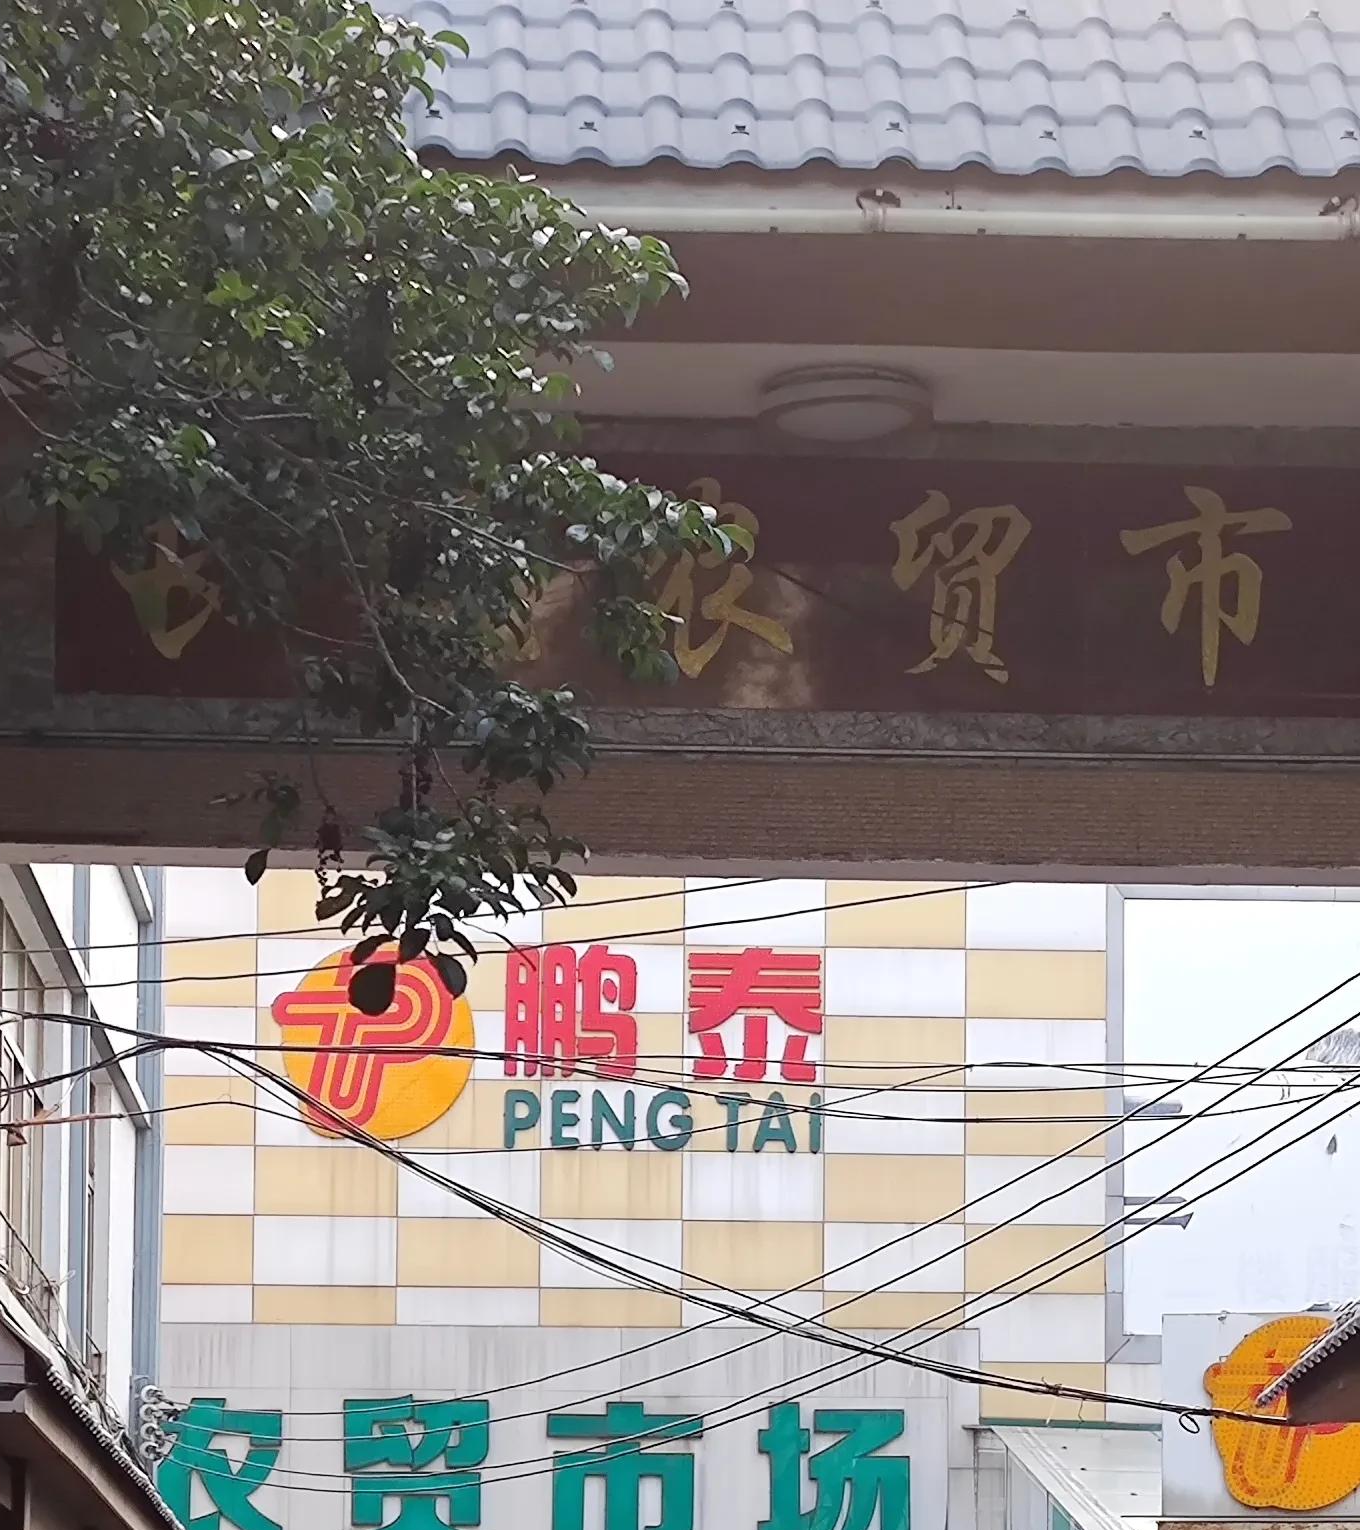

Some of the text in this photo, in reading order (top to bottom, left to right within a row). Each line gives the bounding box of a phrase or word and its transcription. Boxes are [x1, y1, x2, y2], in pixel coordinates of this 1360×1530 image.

[502, 943, 825, 1081] 鹏泰
[502, 1089, 823, 1155] PENG TAI
